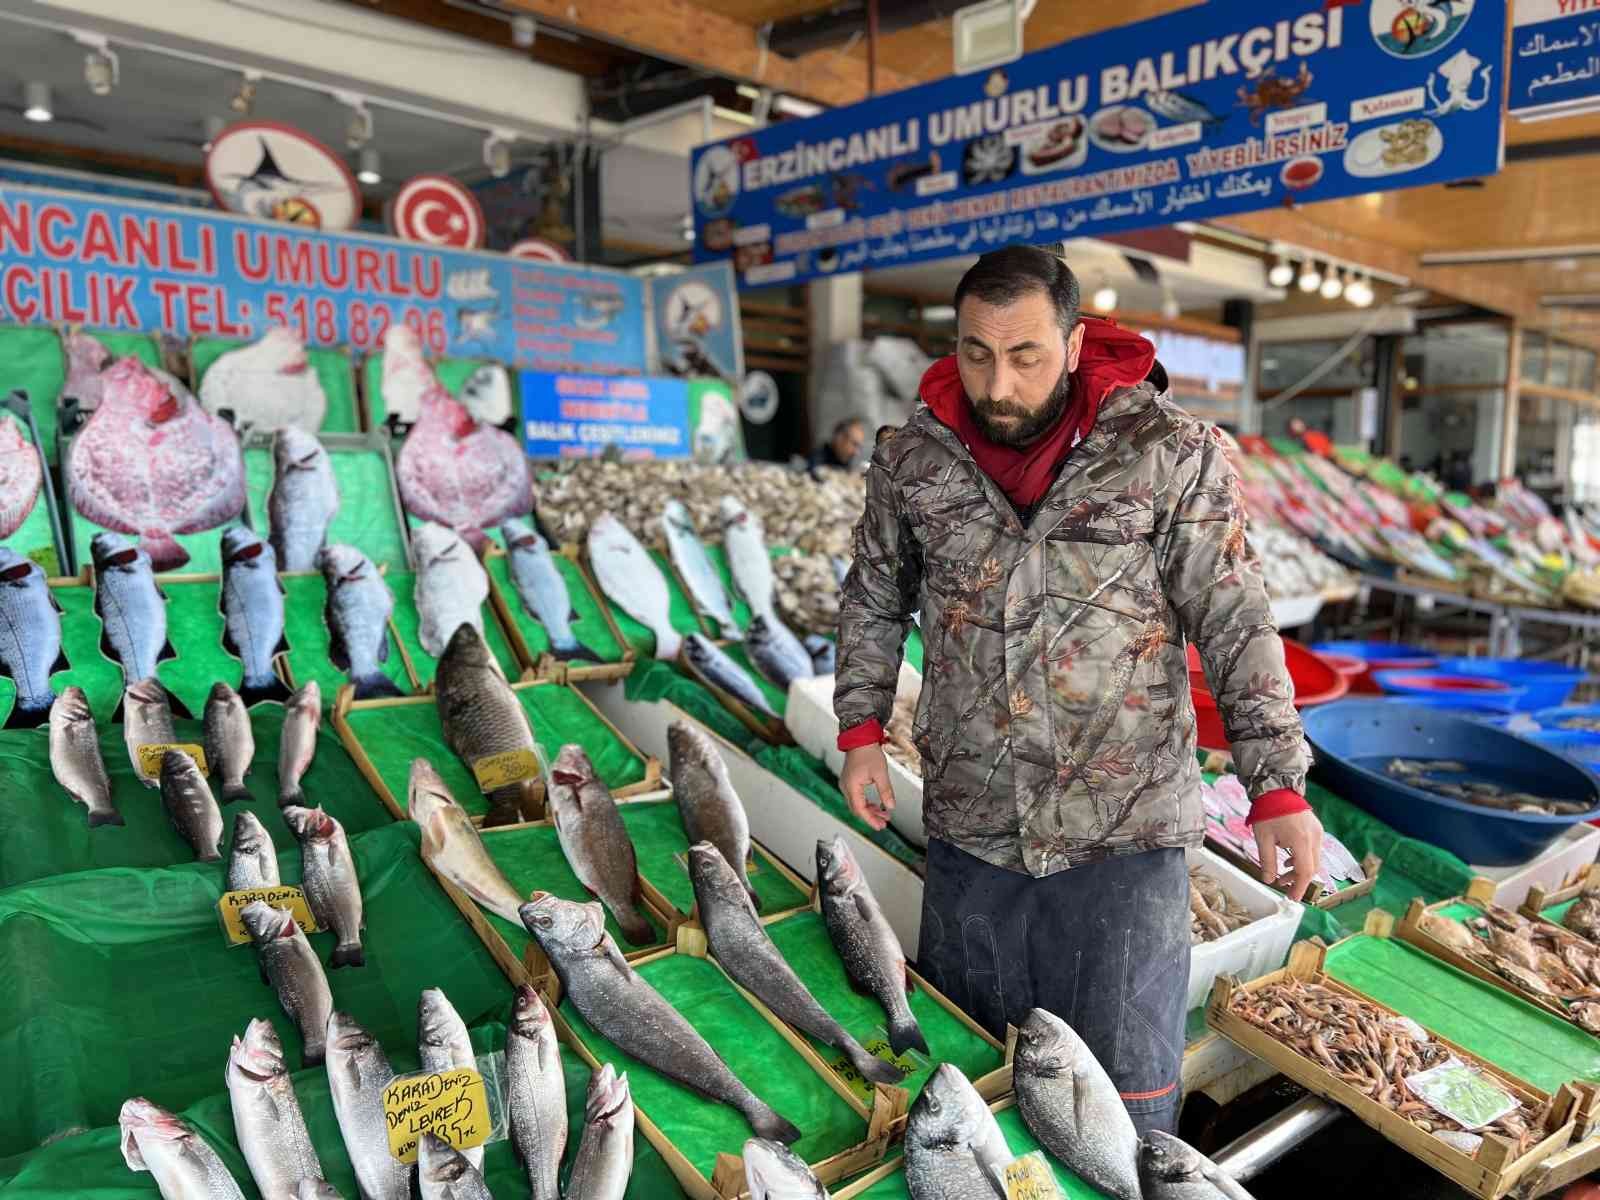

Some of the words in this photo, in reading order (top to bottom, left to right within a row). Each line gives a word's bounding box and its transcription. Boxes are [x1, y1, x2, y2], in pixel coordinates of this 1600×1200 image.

[743, 119, 919, 191] ERZİNCANLI
[929, 74, 1087, 145] UMURLU
[1100, 7, 1343, 96] BALIKÇISI
[1187, 123, 1348, 176] YİYEBİLİRSİNİZ
[0, 201, 216, 275] NCANLI
[234, 233, 442, 300] UMURLU
[0, 266, 140, 328] ÇILIK
[153, 281, 251, 337] TEL:
[265, 293, 337, 346] 518
[351, 302, 392, 349] 82
[403, 307, 447, 354] 96
[409, 1089, 473, 1134] LEVREK
